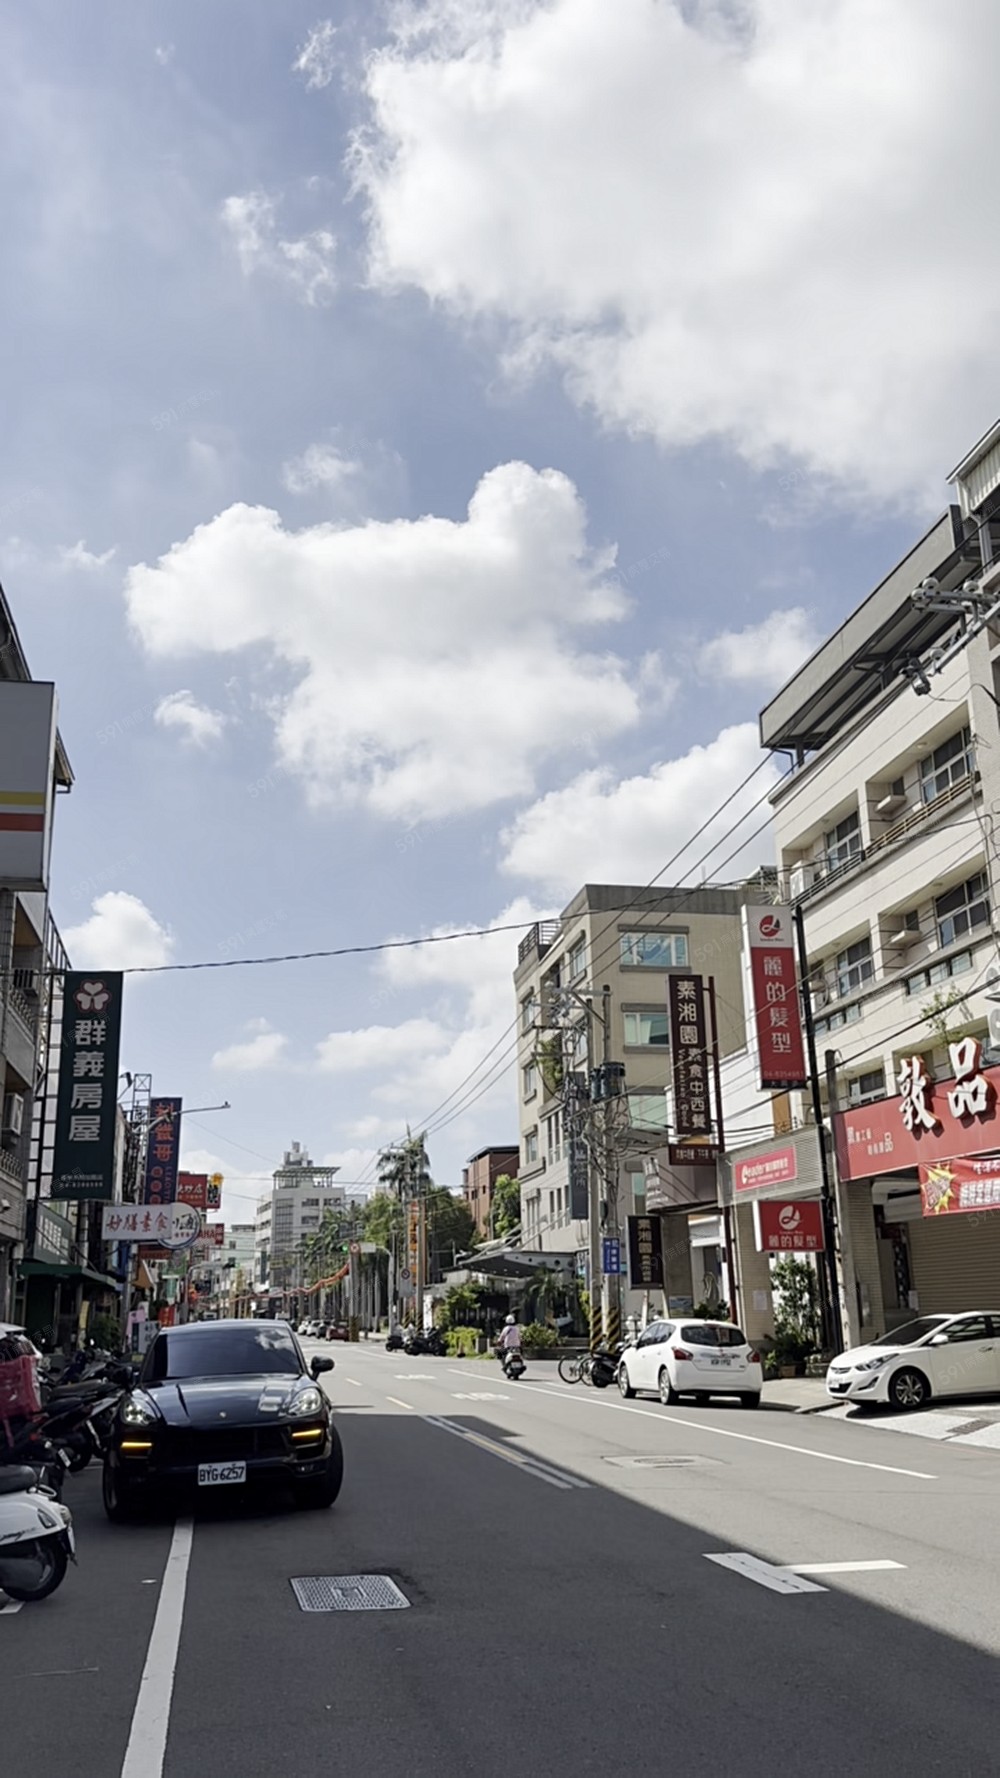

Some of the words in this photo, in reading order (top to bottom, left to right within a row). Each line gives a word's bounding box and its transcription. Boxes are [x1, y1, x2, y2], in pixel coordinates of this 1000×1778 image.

[677, 980, 699, 1045] 素湘園
[763, 955, 792, 1054] 麗的髮型
[68, 1019, 107, 1142] 群義房屋
[688, 1046, 707, 1129] 素食中西餐
[106, 1211, 169, 1232] 妙膳素食
